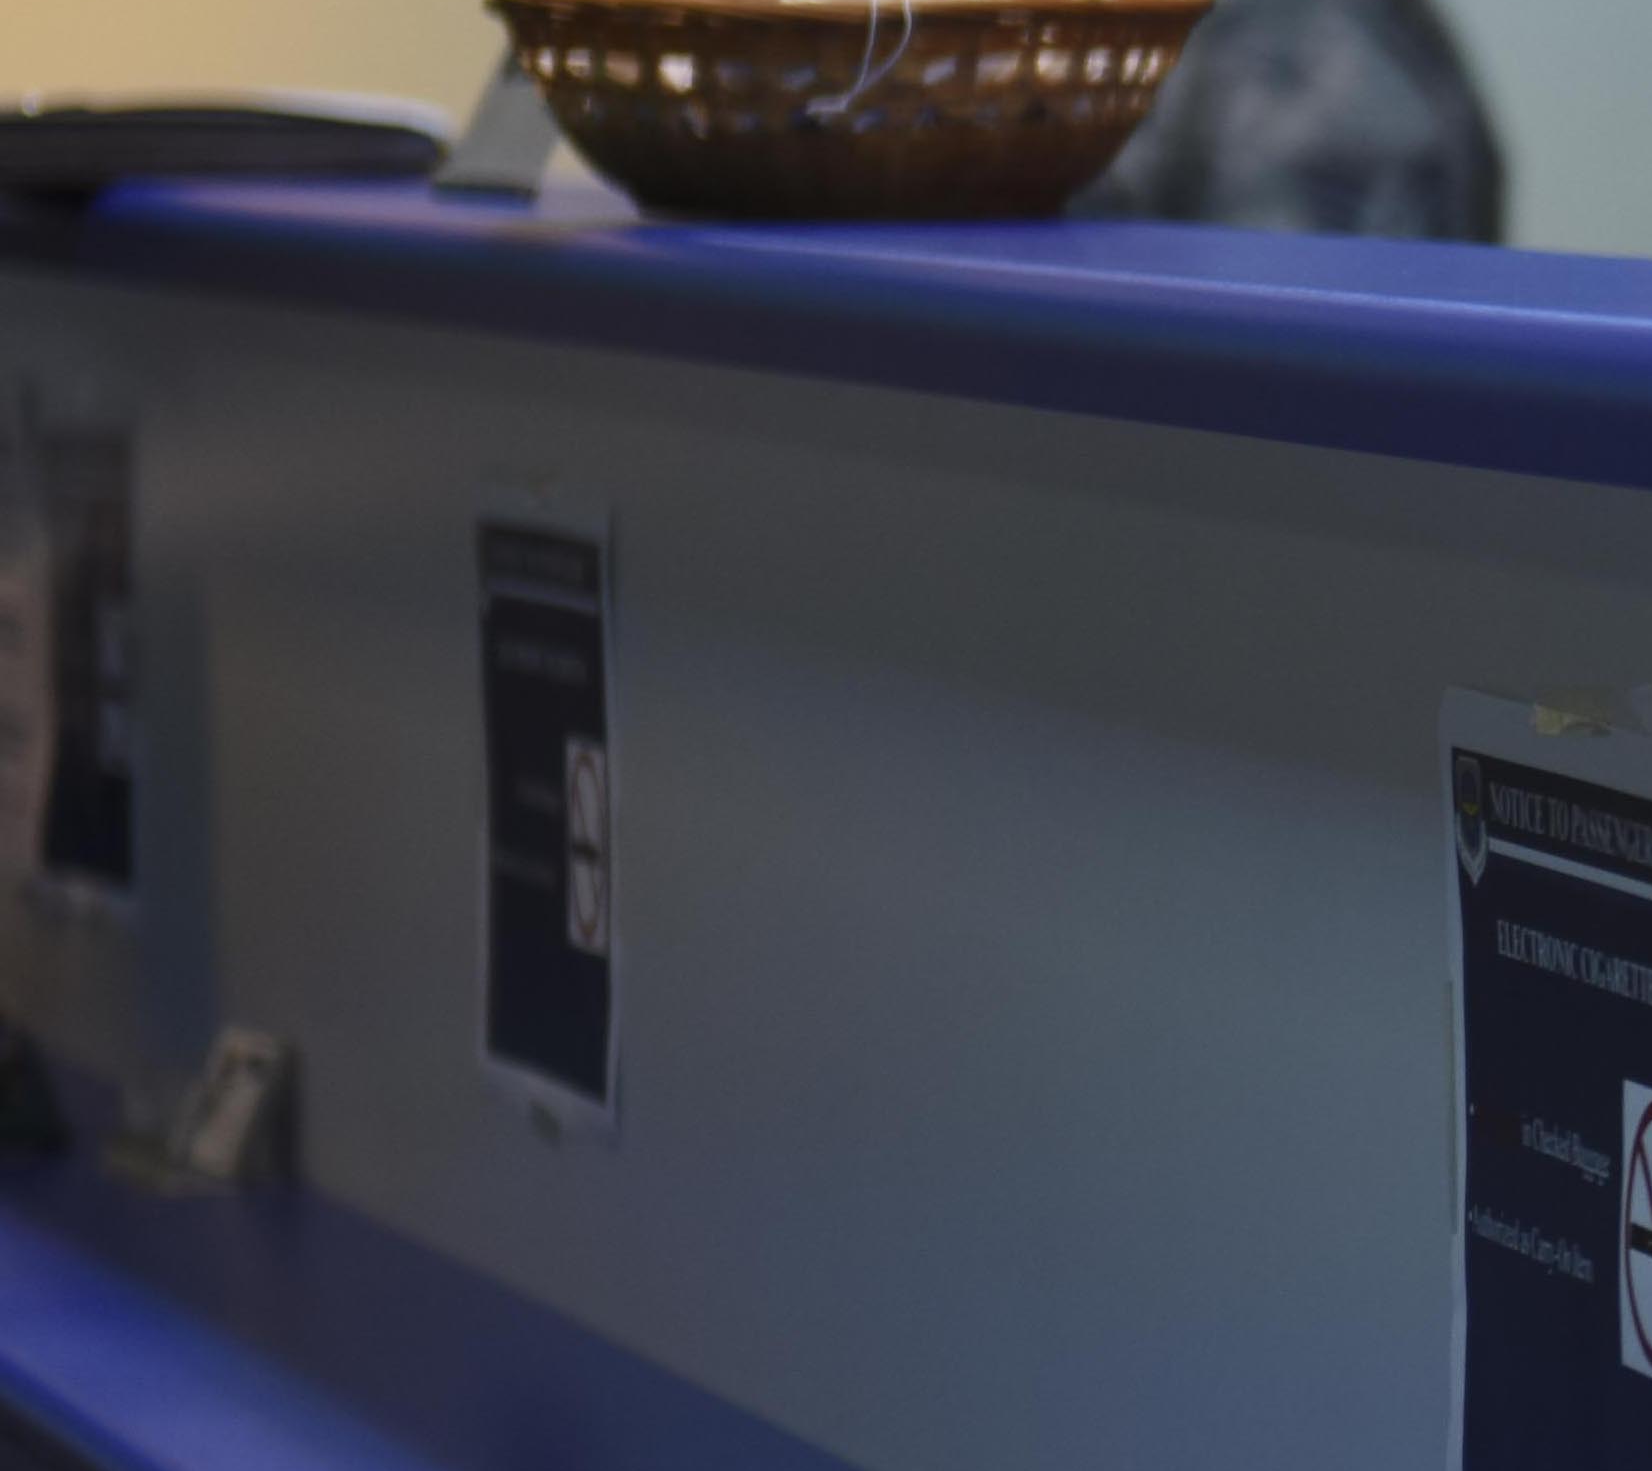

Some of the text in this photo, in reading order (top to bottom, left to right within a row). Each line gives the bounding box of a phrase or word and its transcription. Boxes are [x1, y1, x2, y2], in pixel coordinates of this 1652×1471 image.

[1489, 783, 1545, 835] NOTICE
[1549, 800, 1569, 842] TO
[1497, 920, 1578, 983] ELECTRONIC
